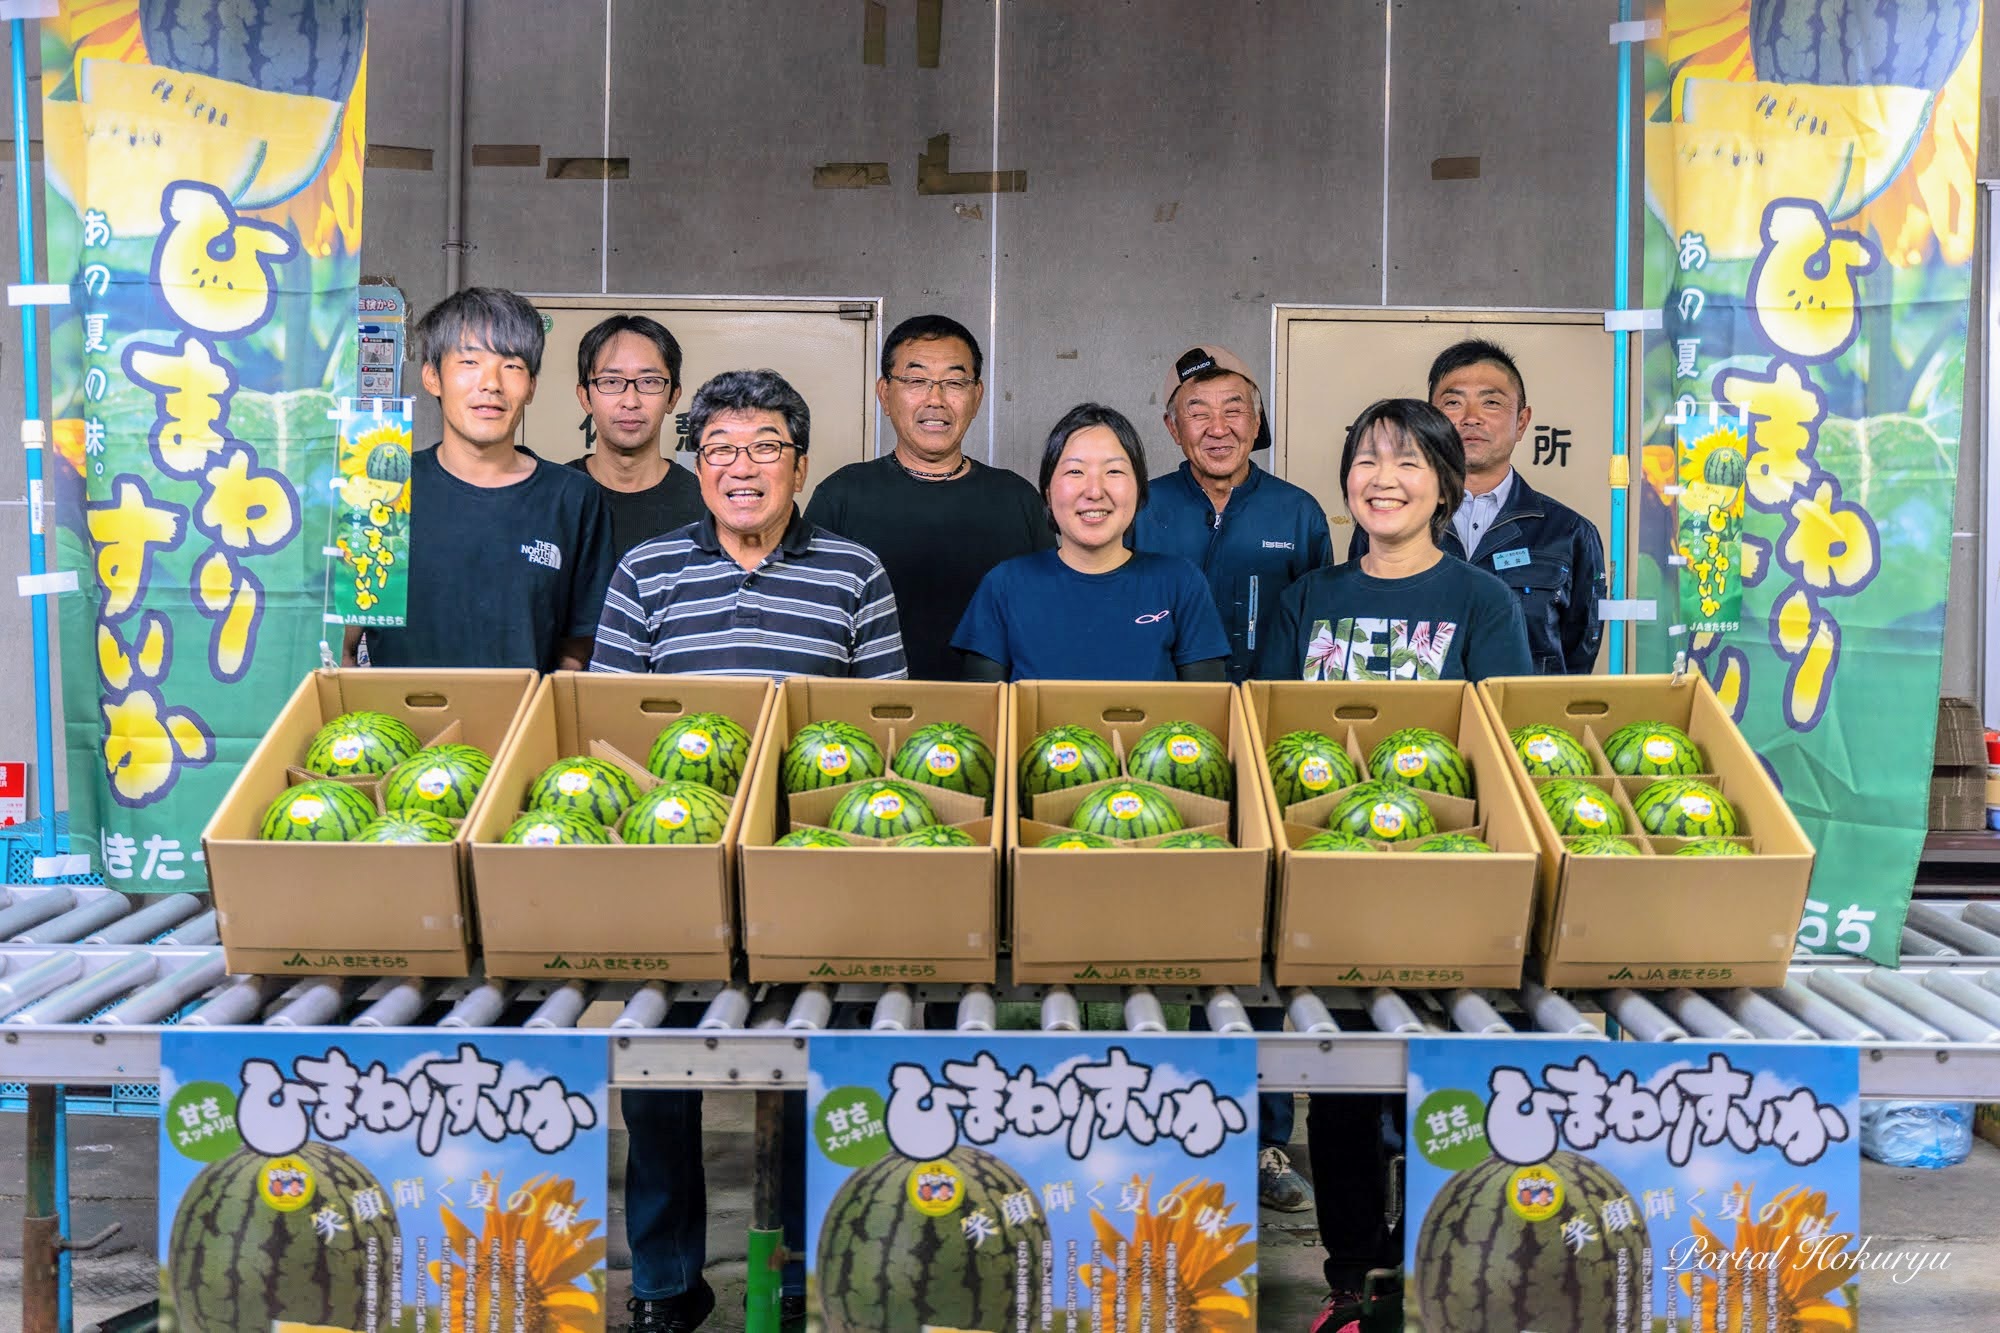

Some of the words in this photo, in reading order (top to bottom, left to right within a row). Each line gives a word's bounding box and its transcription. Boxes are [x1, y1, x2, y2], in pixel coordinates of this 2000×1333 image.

[120, 178, 300, 682] ひまわり
[521, 544, 551, 558] NORTH
[529, 554, 551, 566] FACE
[535, 539, 551, 551] THE
[1303, 617, 1457, 682] NEW
[177, 1096, 221, 1128] 甘さ
[236, 1043, 597, 1157] ひまわりすいか
[885, 1046, 1247, 1160] ひまわりすいか
[1484, 1053, 1849, 1166] ひまわりすいか
[826, 1102, 870, 1133] 甘さ
[1425, 1104, 1469, 1136] 甘さ
